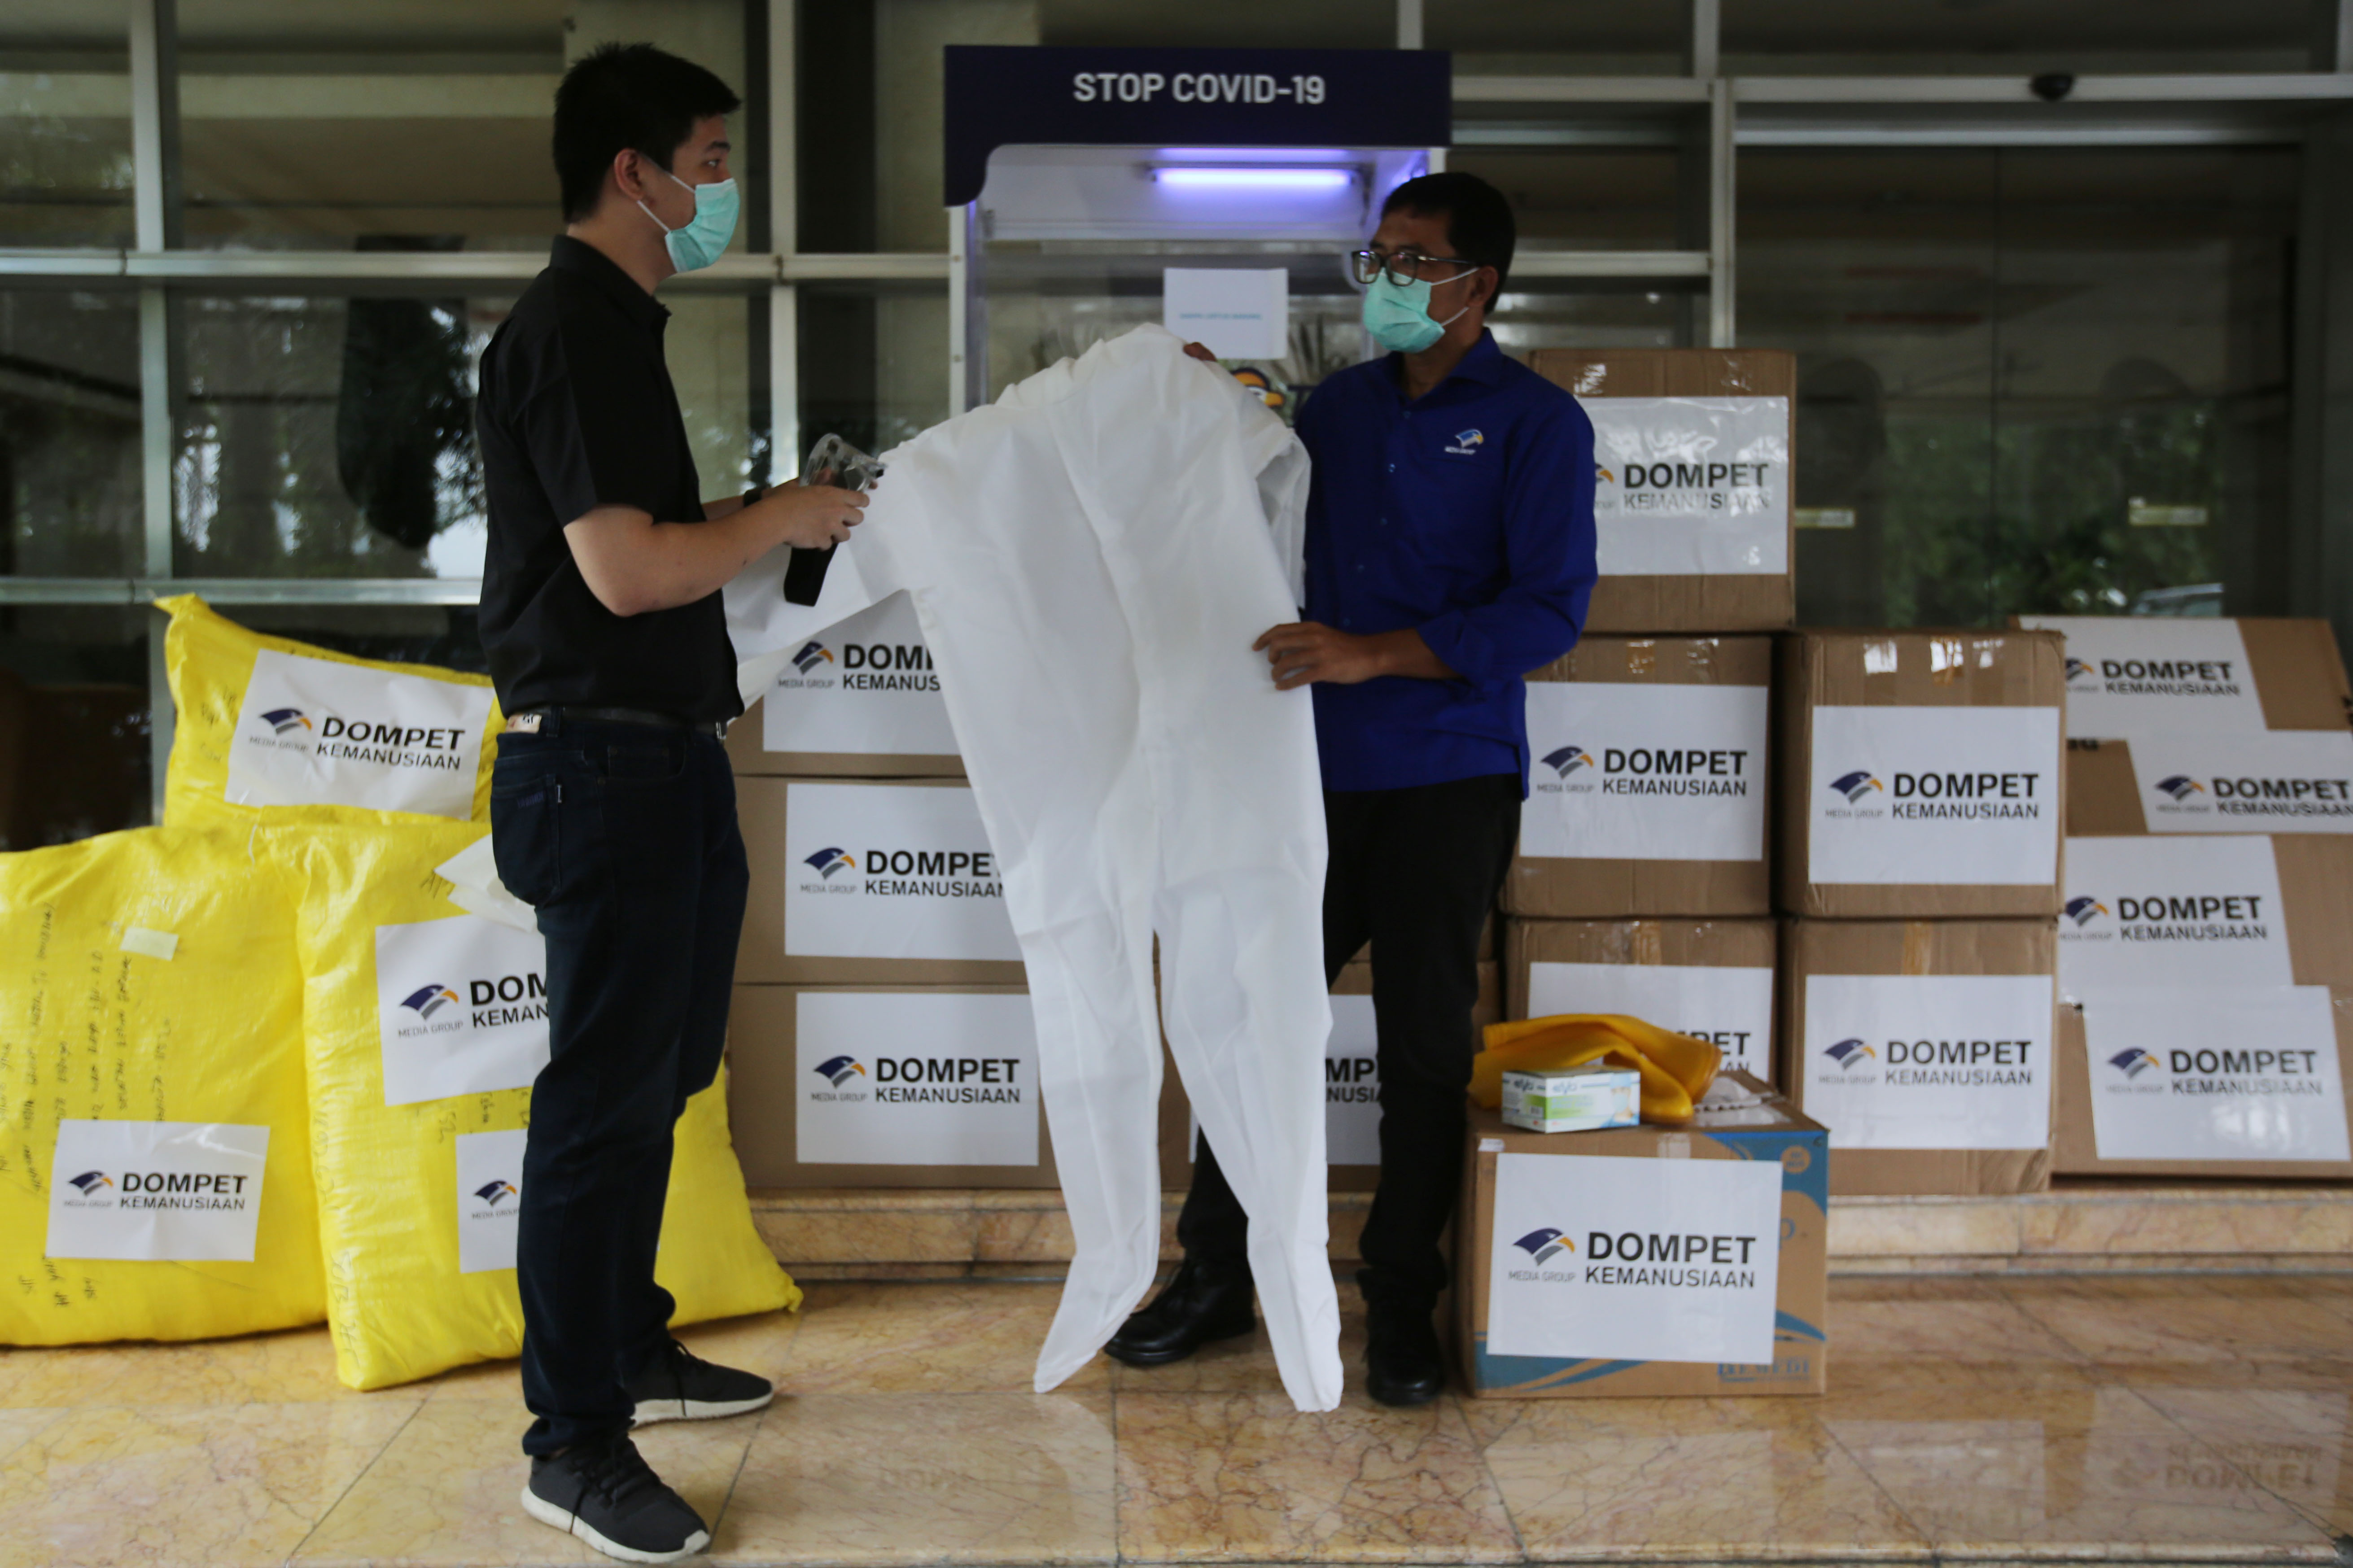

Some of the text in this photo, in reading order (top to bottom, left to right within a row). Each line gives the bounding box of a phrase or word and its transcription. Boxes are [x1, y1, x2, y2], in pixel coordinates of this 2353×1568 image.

[1073, 72, 1325, 105] STOP COVID-19
[1625, 463, 1768, 489] DOMPET
[844, 644, 933, 672] DOM
[2101, 660, 2232, 681] DOMPET
[843, 674, 940, 691] KEMANUS
[2105, 682, 2240, 696] KEMANUSIAAN
[322, 716, 465, 751] DOMPET
[317, 743, 461, 770] KEMANUSIAAN
[1604, 748, 1748, 775] DOMPET
[1603, 779, 1747, 797] KEMANUSIAAN
[1894, 773, 2039, 798] DOMPET
[2212, 777, 2350, 799] DOMPET
[1892, 803, 2039, 820] KEMANUSIAAN
[866, 850, 1000, 877] DOMPE
[2118, 895, 2261, 921] DOMPET
[2119, 925, 2267, 941] KEMANUSIAAN
[470, 973, 547, 1006] DOM
[398, 1021, 464, 1038] MEDIA GROUP
[1887, 1040, 2033, 1065] DOMPET
[2169, 1049, 2319, 1074] DOMPET
[876, 1057, 1020, 1083] DOMPET
[1885, 1070, 2032, 1086] KEMANUSIAAN
[875, 1088, 1020, 1103] KEMANUSIAAN
[2171, 1079, 2322, 1096] KEMANUSIAAN
[122, 1172, 249, 1194] DOMPET
[120, 1196, 245, 1211] KEMANUSIAAN
[1588, 1232, 1756, 1264] DOMPET
[1508, 1270, 1576, 1283] MEDIA GROUP
[1584, 1266, 1755, 1289] KEMANUSIAAN
